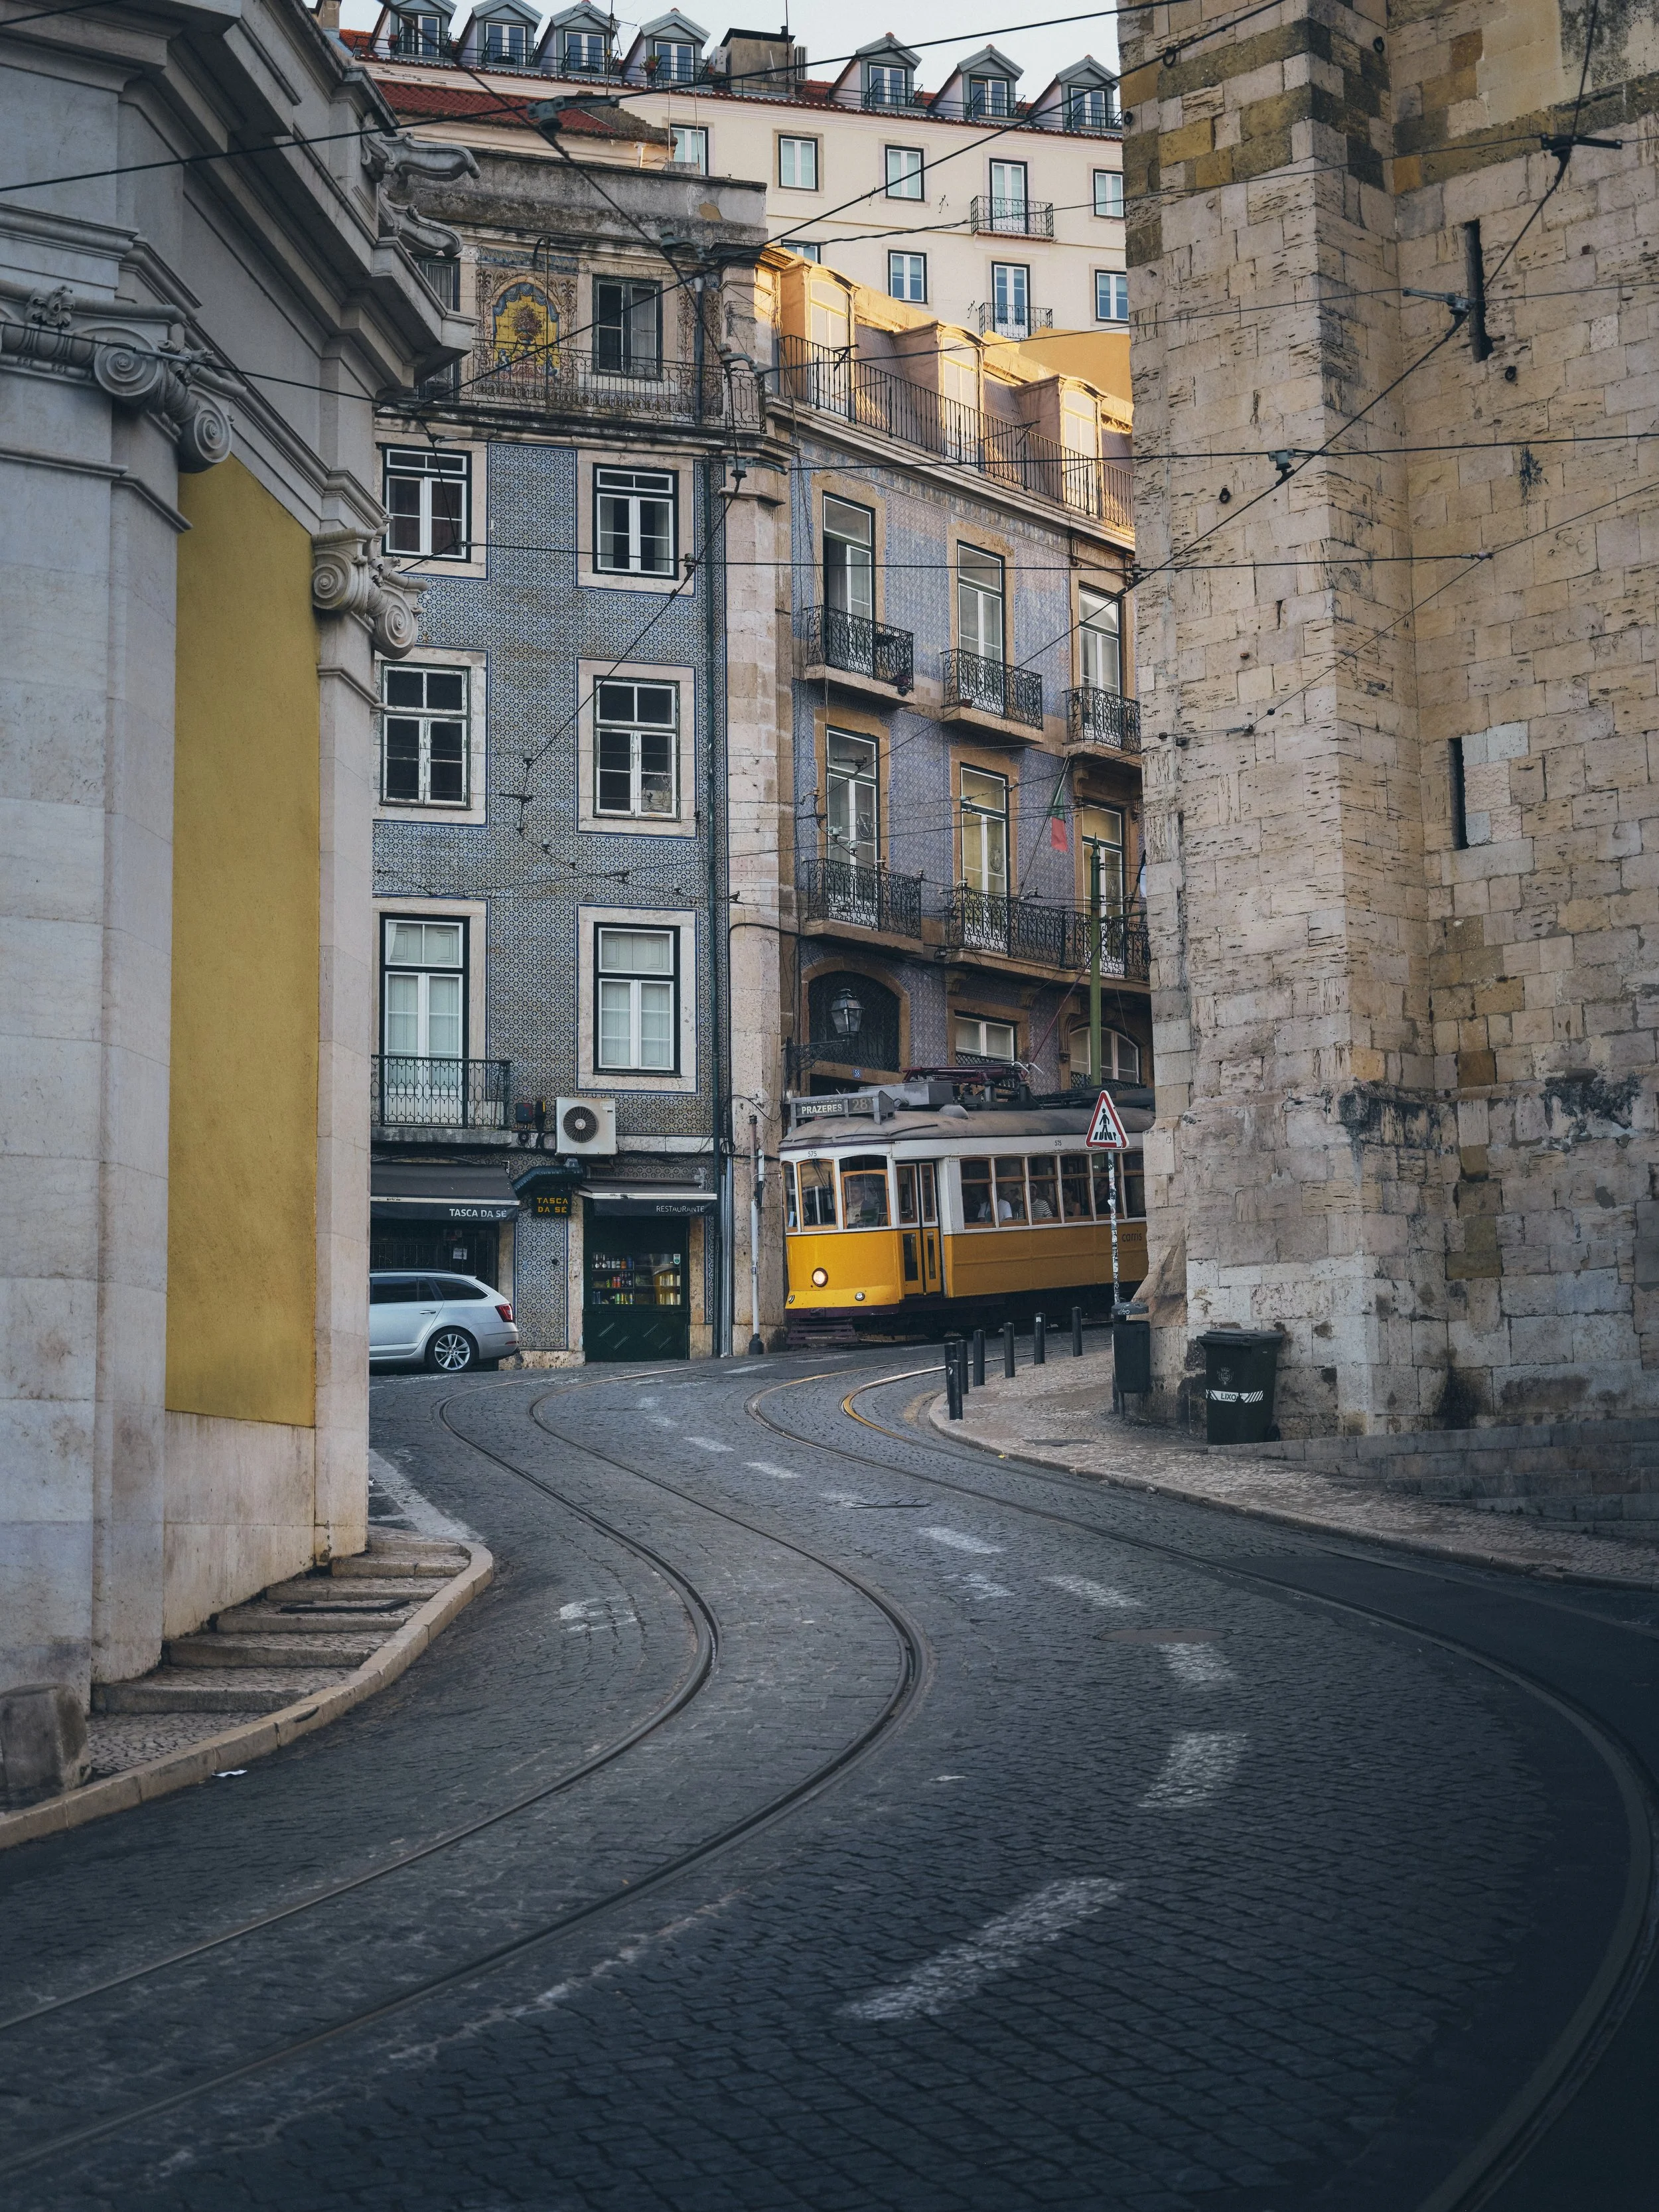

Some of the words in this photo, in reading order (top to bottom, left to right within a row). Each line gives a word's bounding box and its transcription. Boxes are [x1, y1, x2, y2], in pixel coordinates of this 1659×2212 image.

[802, 1104, 843, 1114] PRAZERES
[496, 1209, 507, 1218] SÉ
[1121, 1230, 1142, 1242] carris
